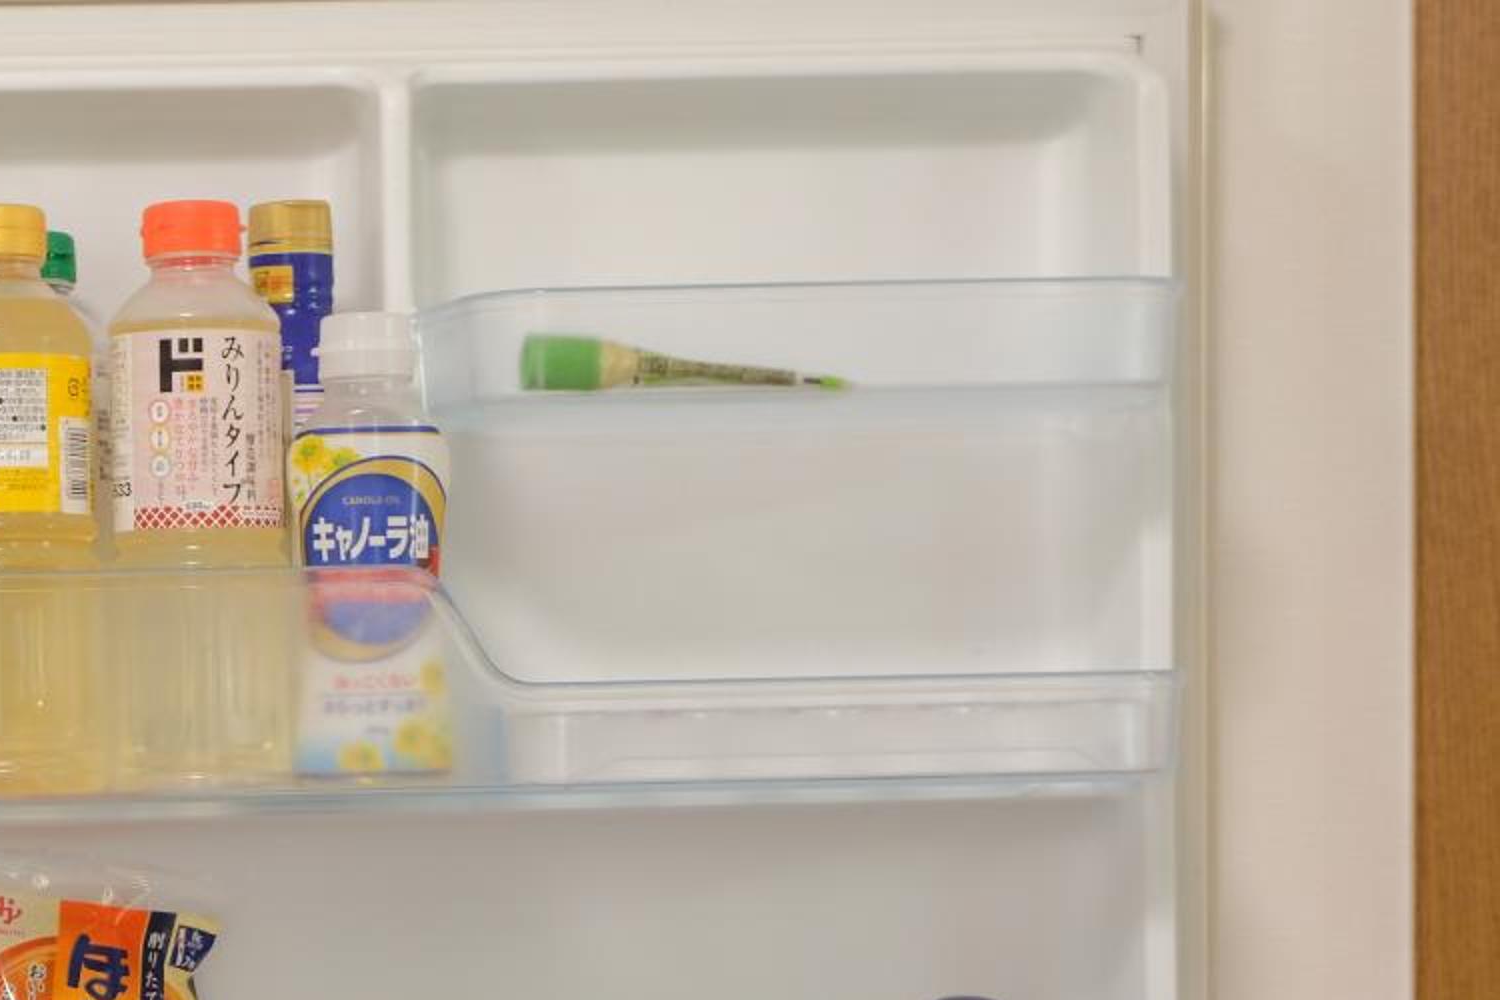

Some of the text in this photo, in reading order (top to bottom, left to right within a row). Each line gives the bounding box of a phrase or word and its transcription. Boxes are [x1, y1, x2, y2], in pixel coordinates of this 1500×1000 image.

[160, 338, 203, 393] ド
[312, 514, 430, 562] キャノーラ油
